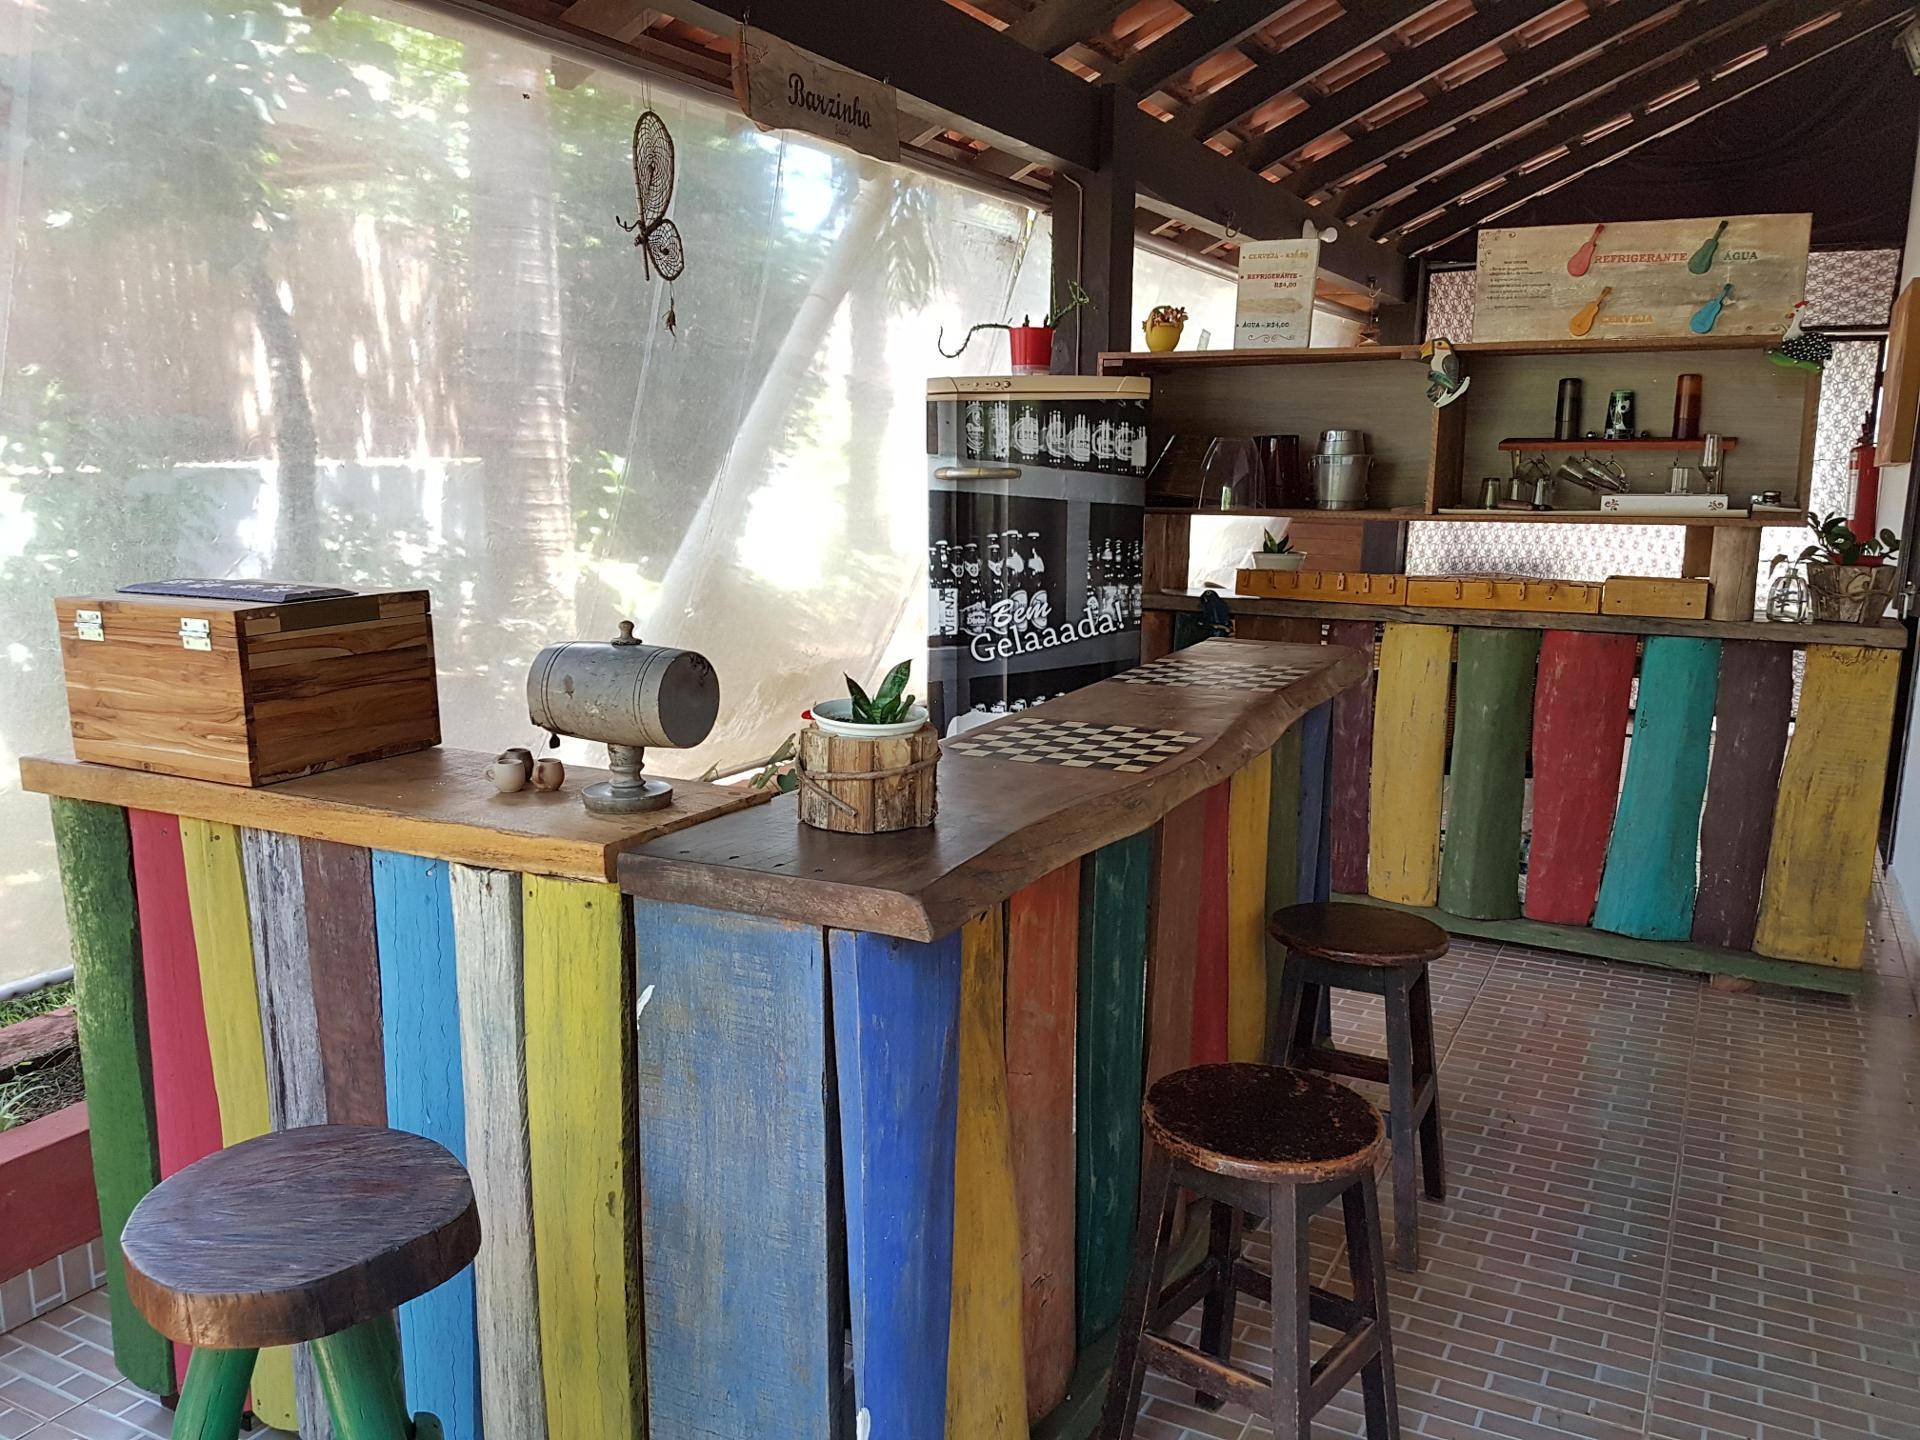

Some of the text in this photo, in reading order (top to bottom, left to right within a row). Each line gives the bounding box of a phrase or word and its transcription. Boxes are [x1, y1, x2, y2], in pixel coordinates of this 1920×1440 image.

[788, 73, 872, 129] Barzinho
[1594, 250, 1758, 263] REFRIGERANTE ÁGUA
[1600, 314, 1654, 324] CERVEJA
[990, 598, 1052, 628] Bem
[970, 601, 1125, 662] Gelaaada!
